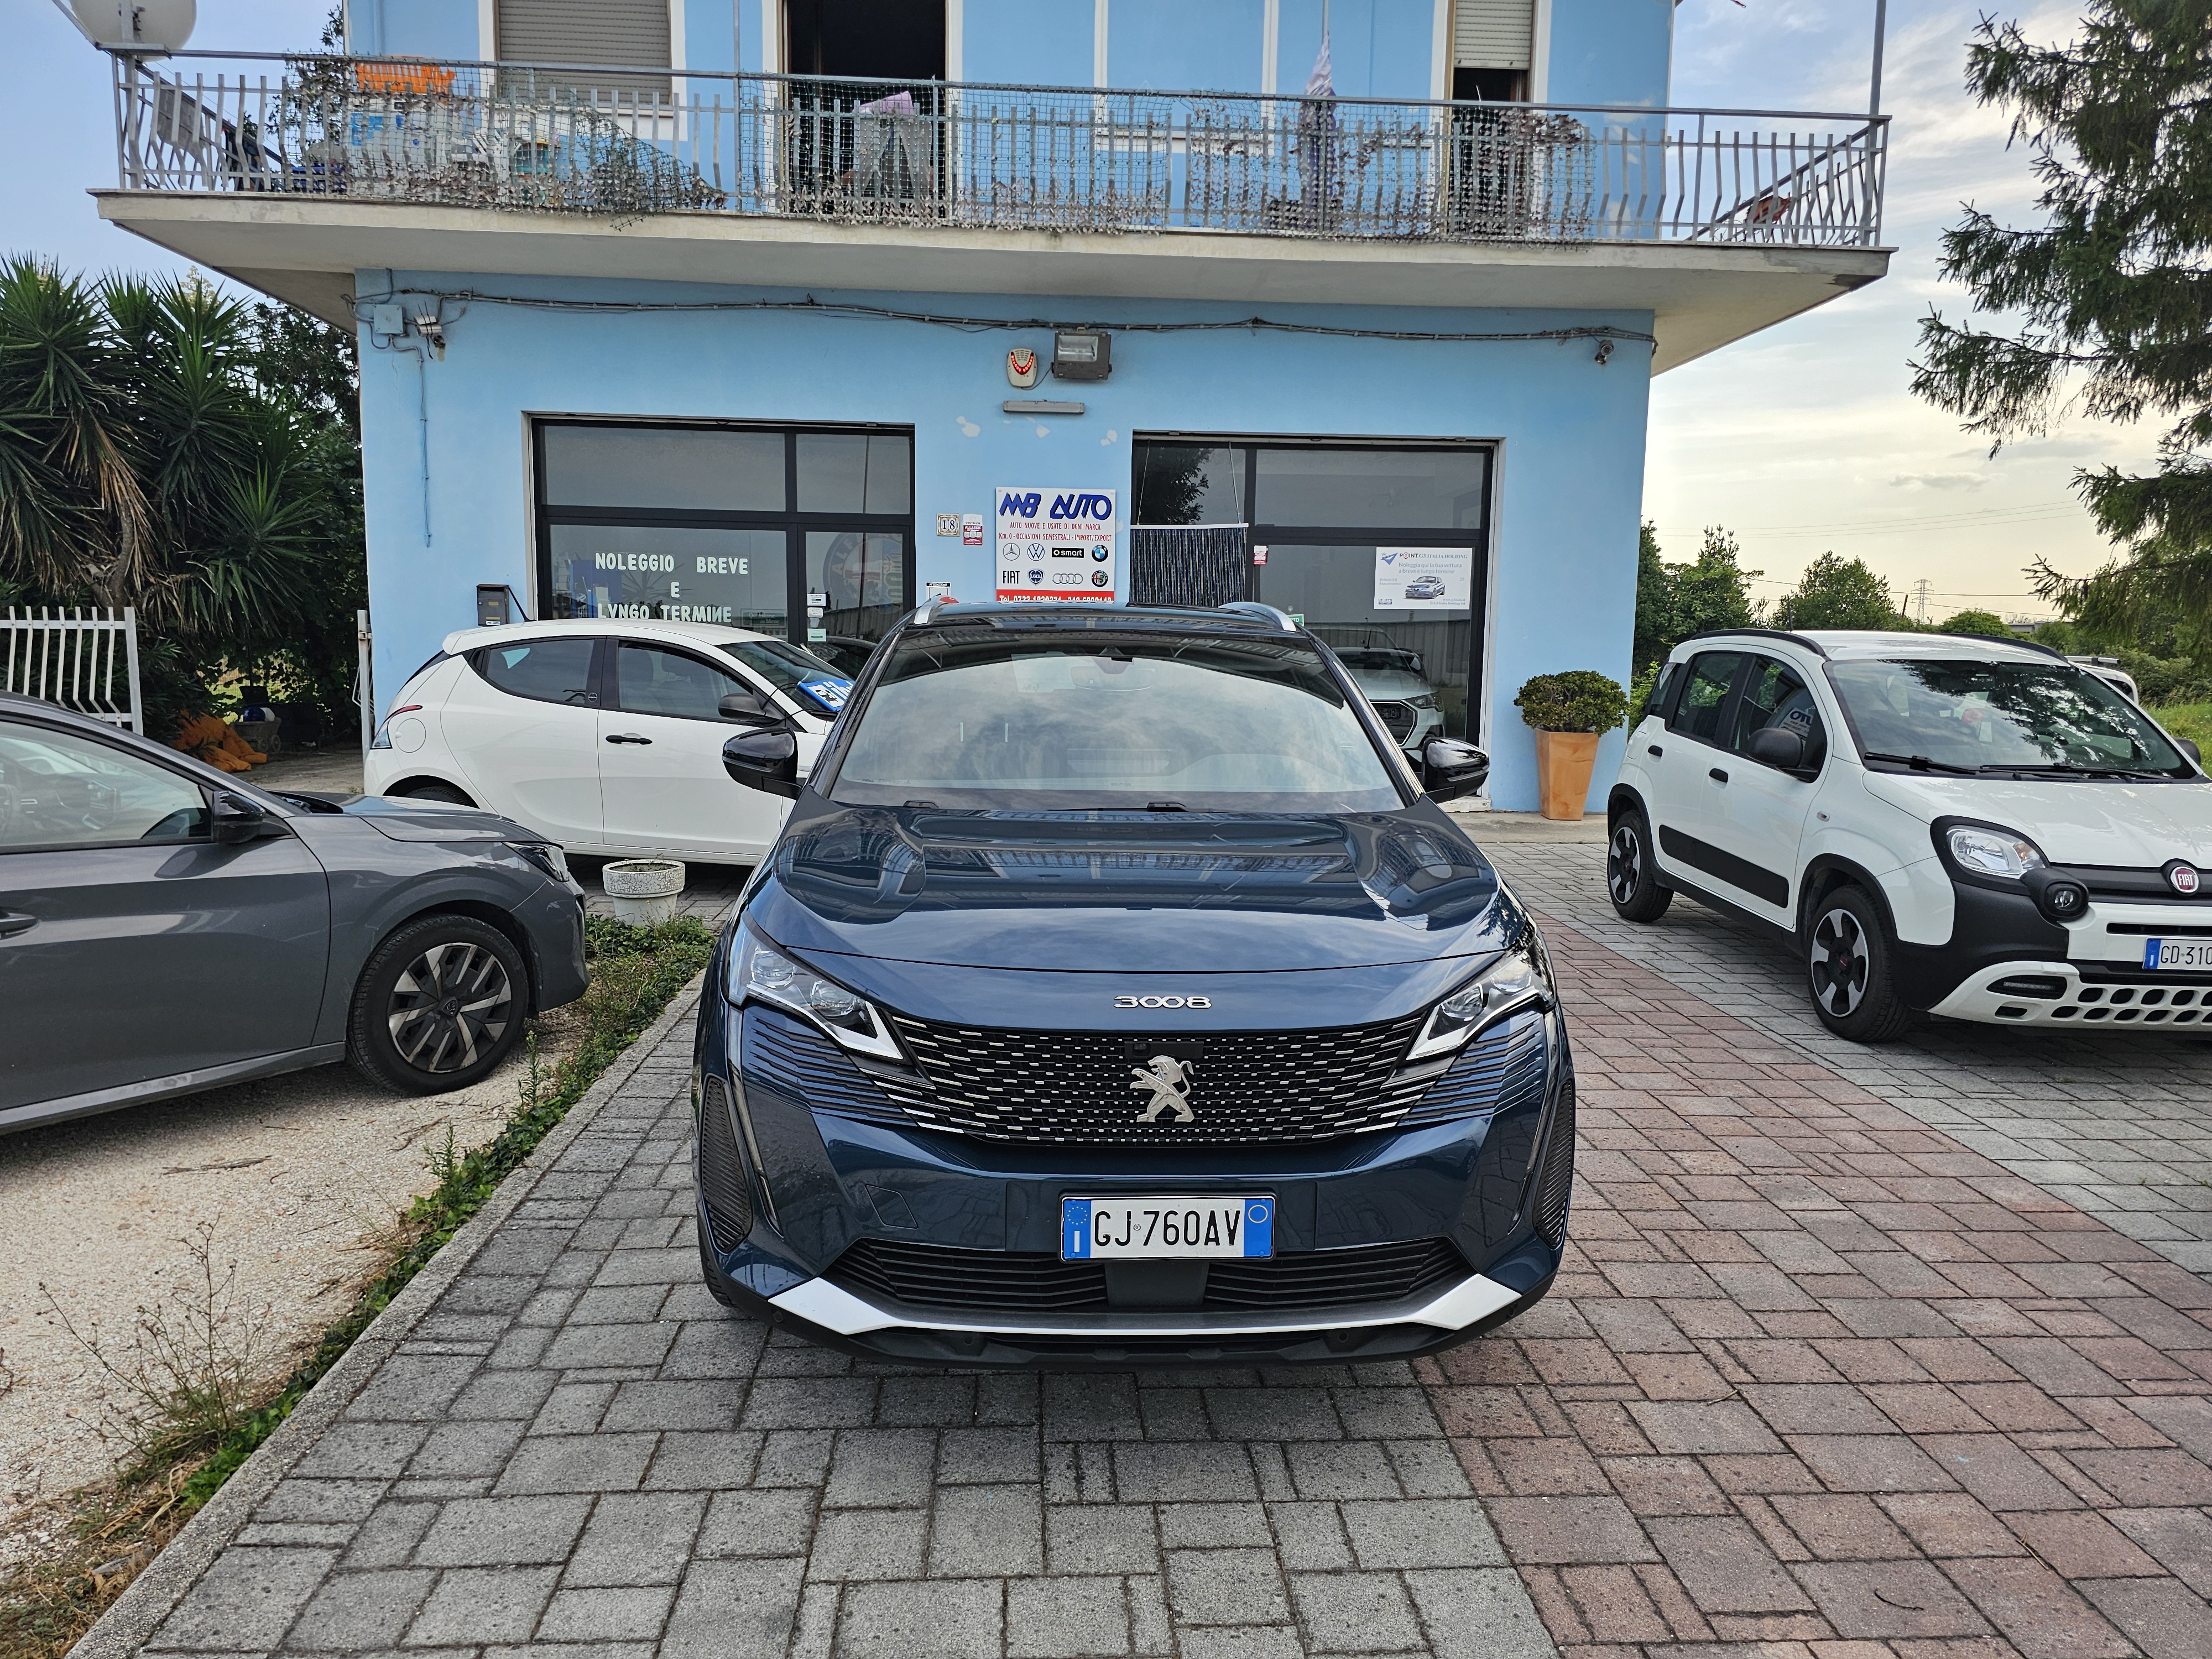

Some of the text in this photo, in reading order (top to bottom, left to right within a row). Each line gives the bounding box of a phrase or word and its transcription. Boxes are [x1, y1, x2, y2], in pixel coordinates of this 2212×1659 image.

[999, 492, 1112, 520] MB AUTO
[943, 520, 955, 530] 18
[595, 552, 748, 575] NOLEGGIO BREVE
[1003, 570, 1020, 584] FIAT
[671, 582, 680, 598] E
[660, 604, 732, 623] TERMINE
[2177, 874, 2193, 886] FIAT
[1114, 996, 1212, 1009] 3008
